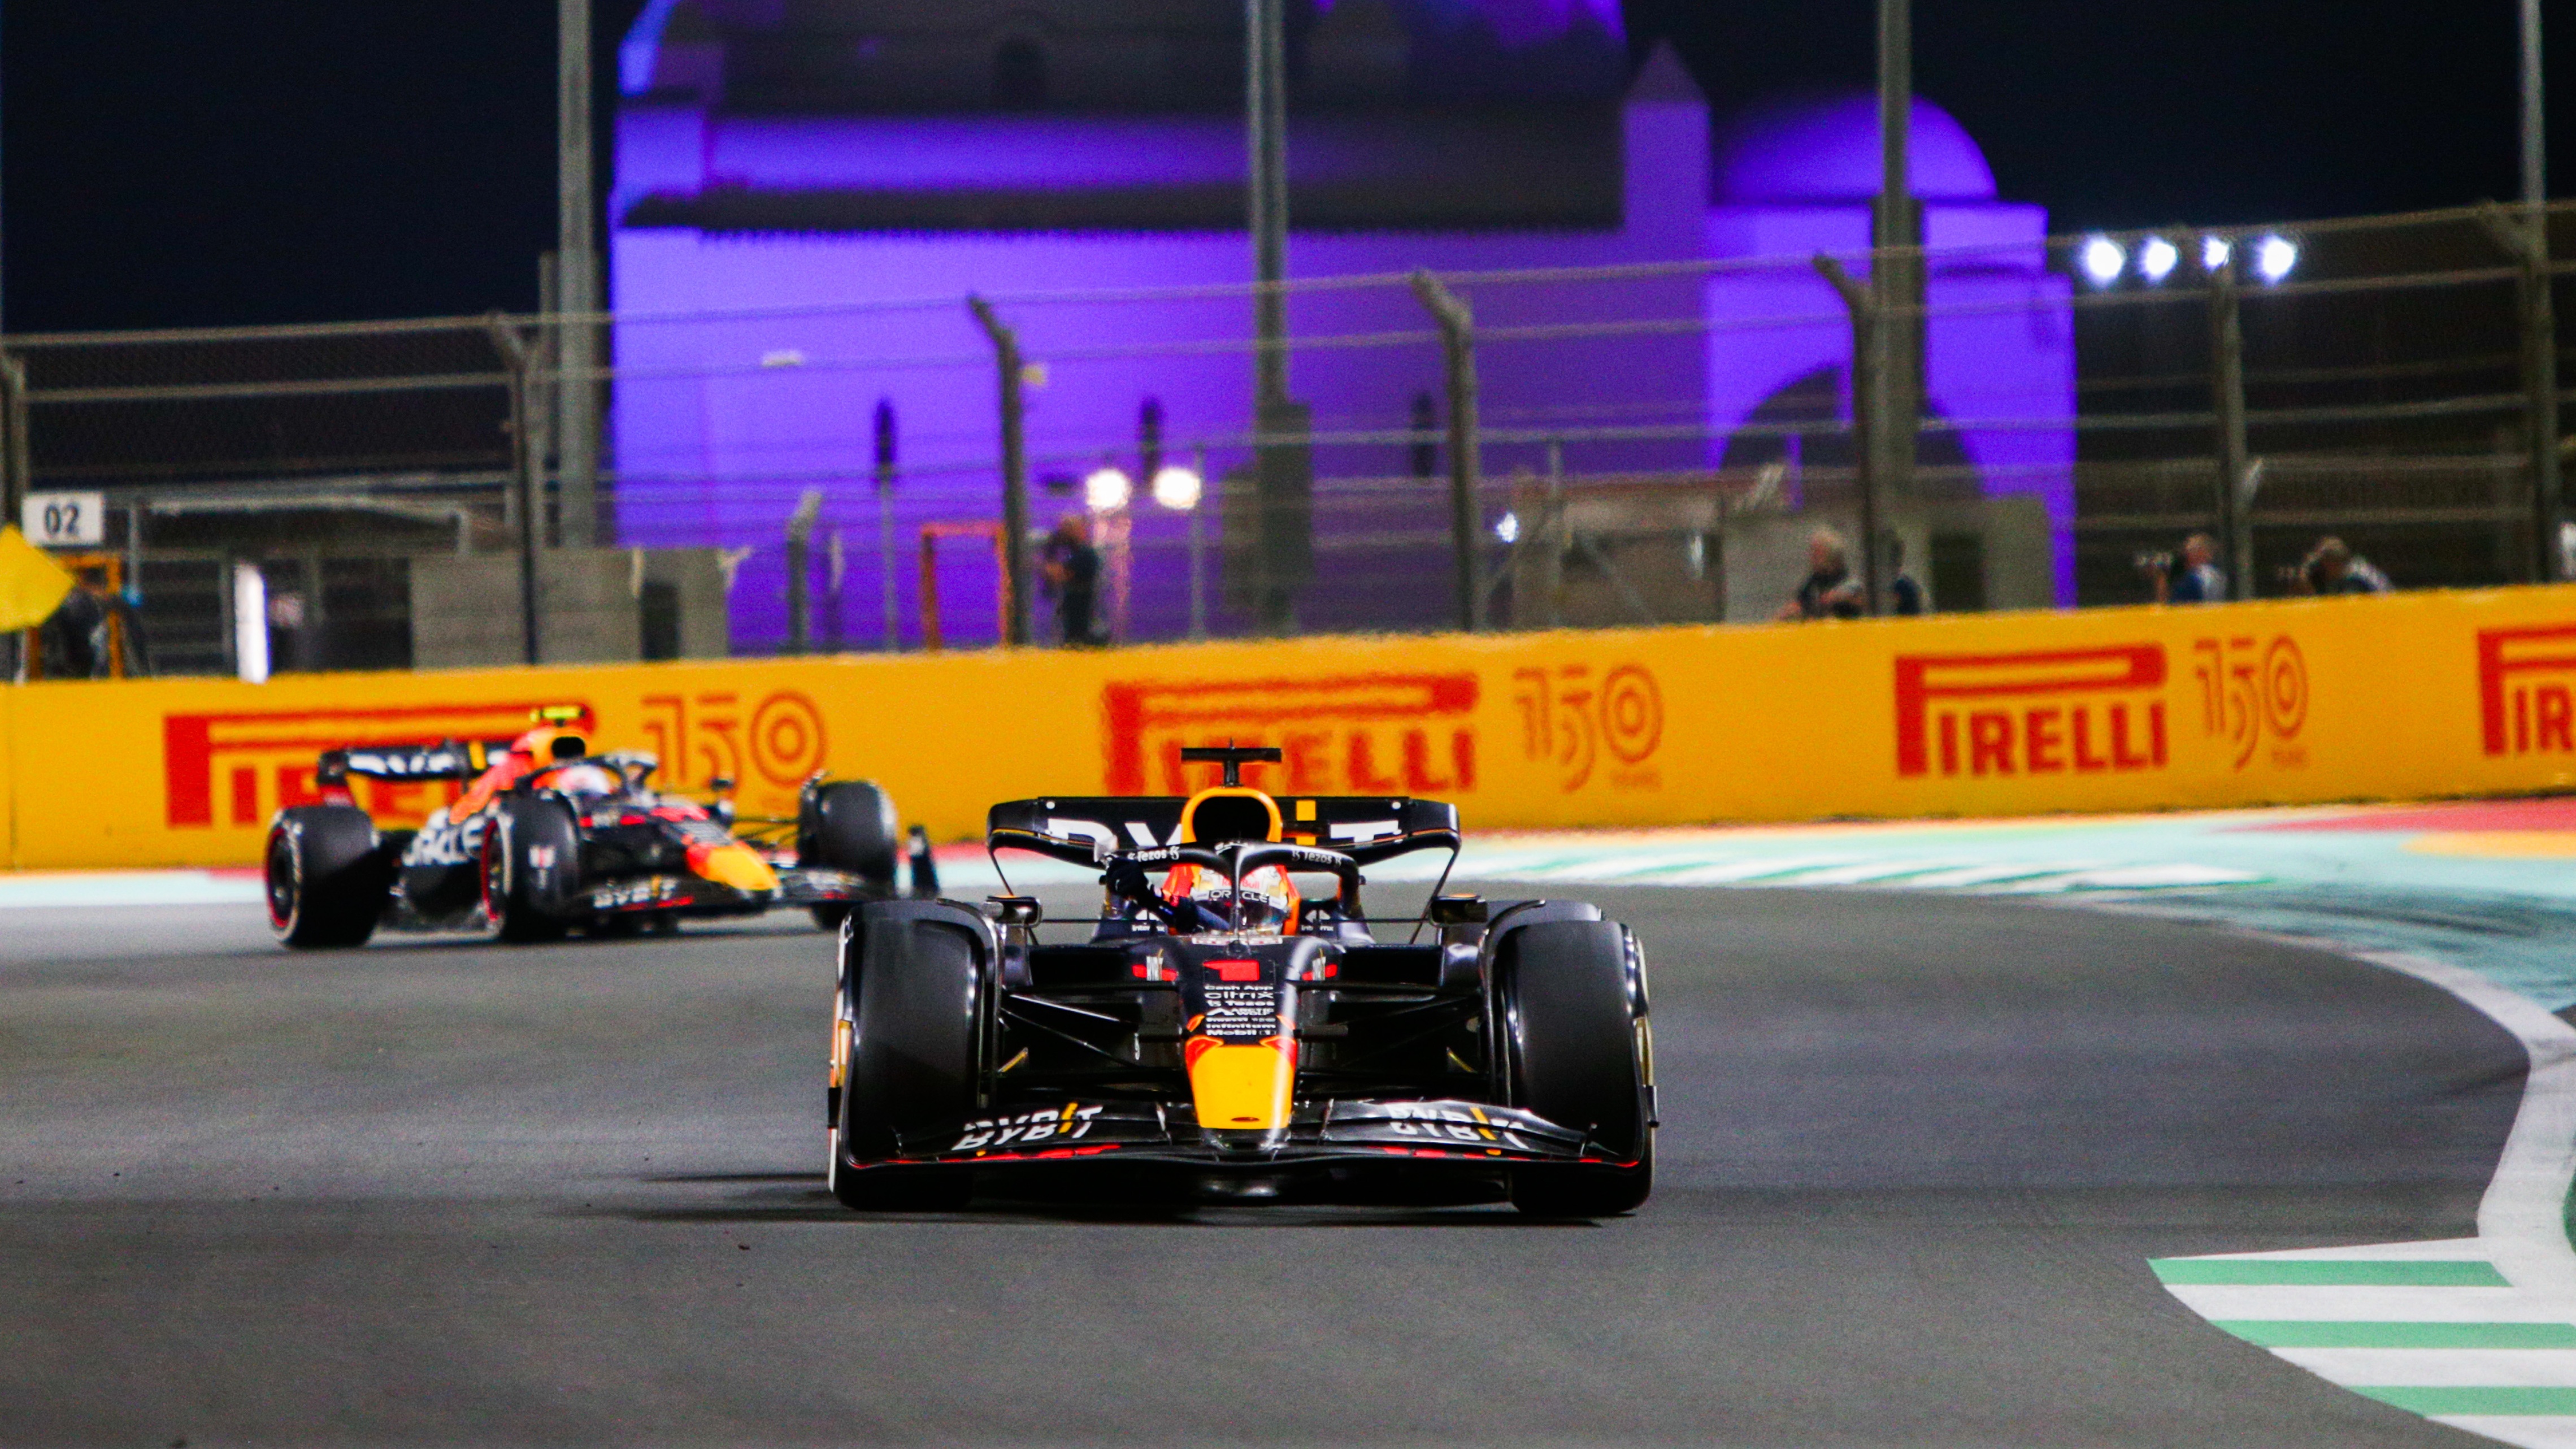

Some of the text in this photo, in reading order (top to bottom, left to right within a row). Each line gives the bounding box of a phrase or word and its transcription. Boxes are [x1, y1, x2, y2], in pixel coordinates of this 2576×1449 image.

[45, 504, 80, 536] 02
[1894, 635, 2309, 777] PIRELLI 150
[1514, 665, 1664, 792] 150
[641, 691, 826, 800] 150
[1137, 849, 1167, 862] Tezos
[1304, 852, 1333, 865] Tezos
[1210, 889, 1268, 904] ORCLE
[1203, 959, 1260, 982] 1
